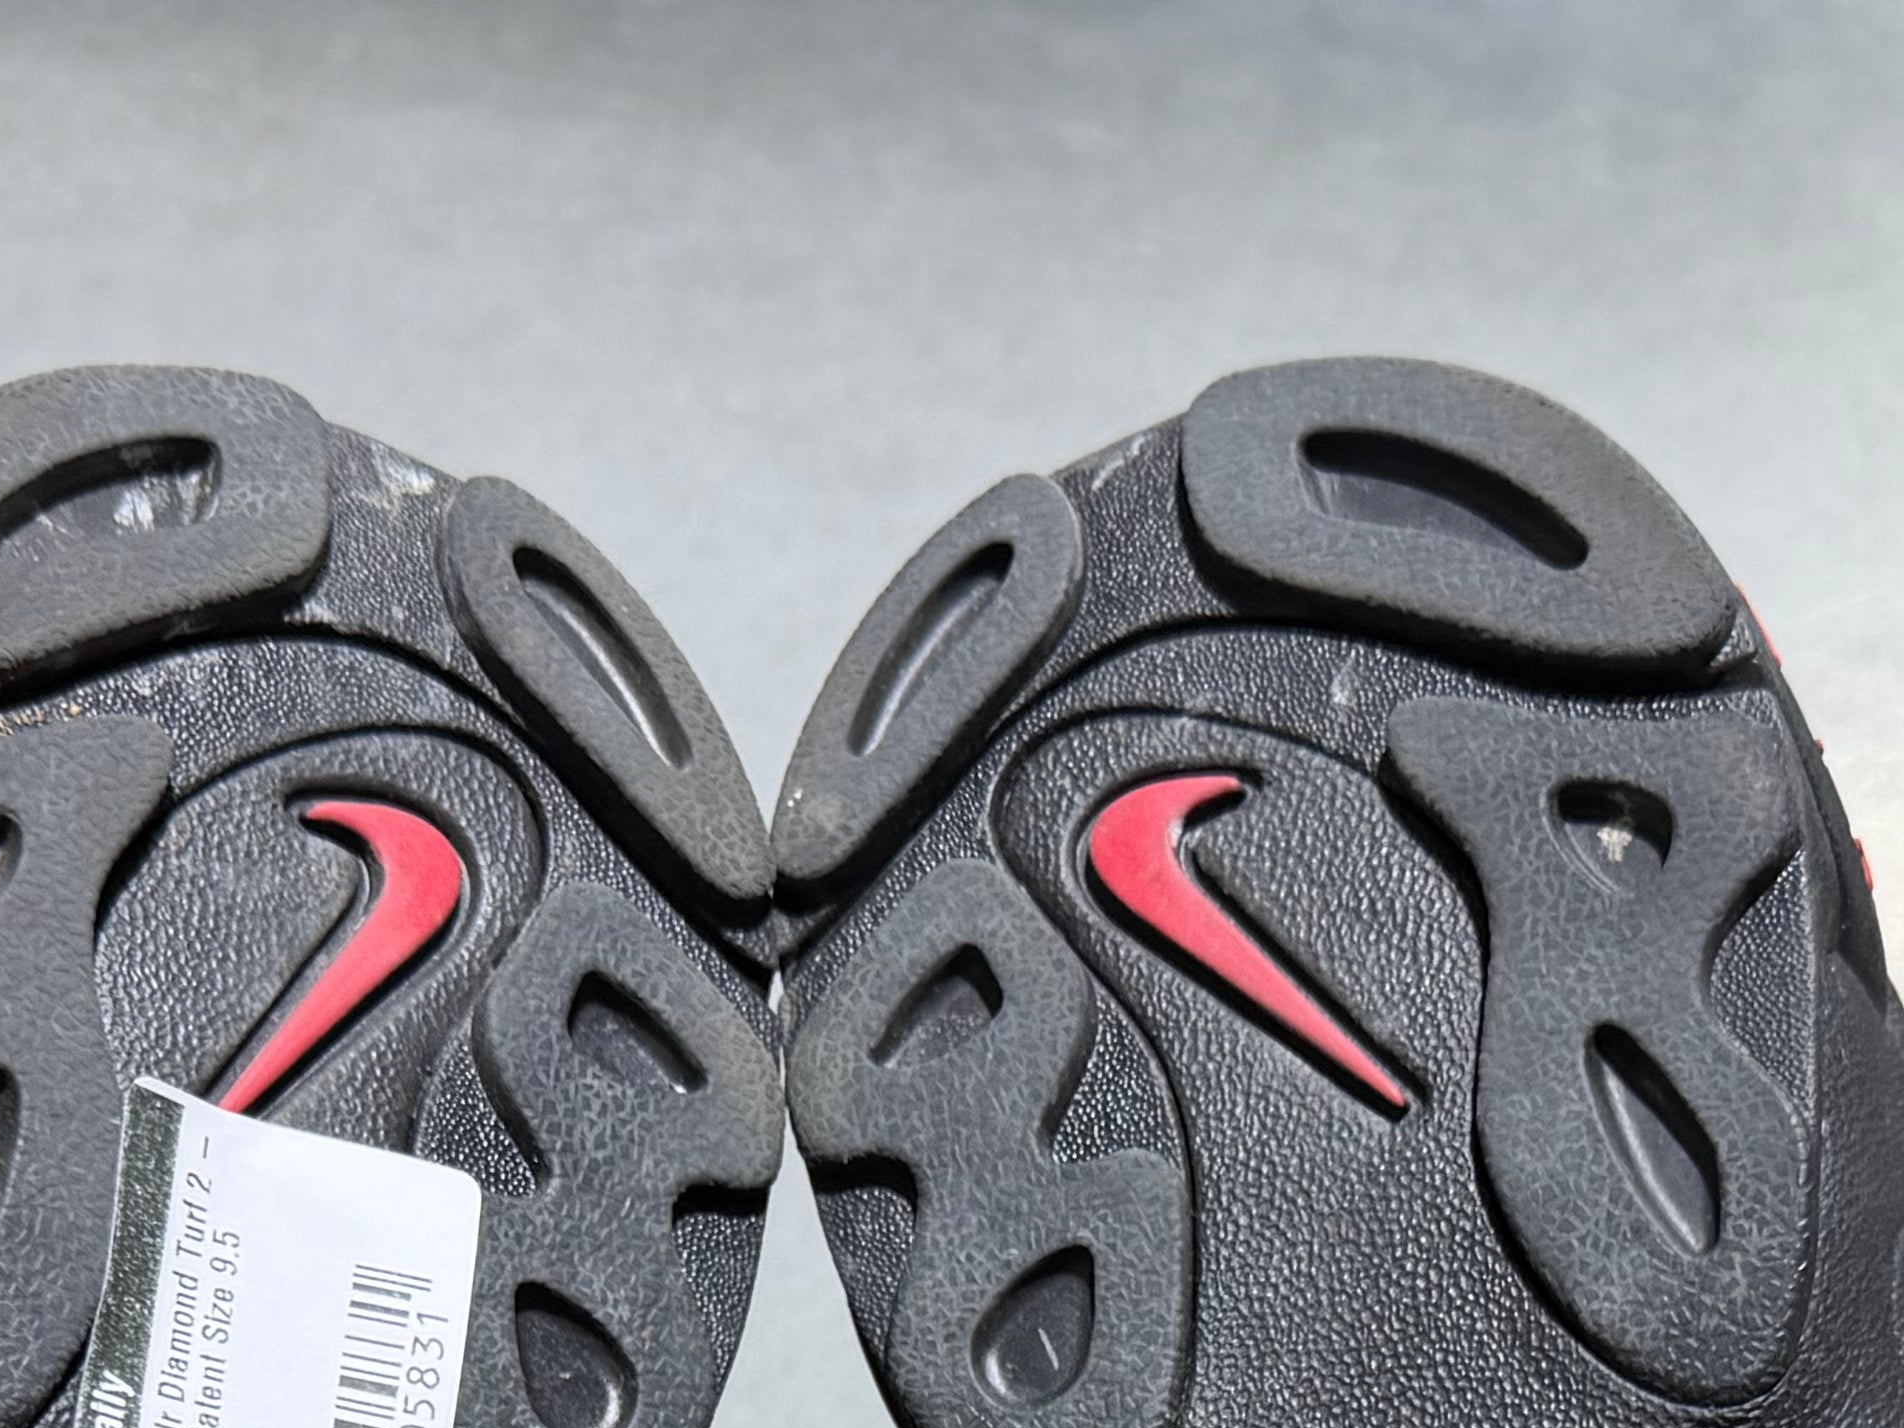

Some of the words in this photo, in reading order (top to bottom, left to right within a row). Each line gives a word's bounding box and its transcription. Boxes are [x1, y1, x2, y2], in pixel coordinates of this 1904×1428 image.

[186, 1172, 213, 1194] 2
[175, 1198, 208, 1257] Turf
[209, 1229, 241, 1276] 9.5
[157, 1270, 199, 1402] Diamond
[201, 1287, 235, 1344] Size
